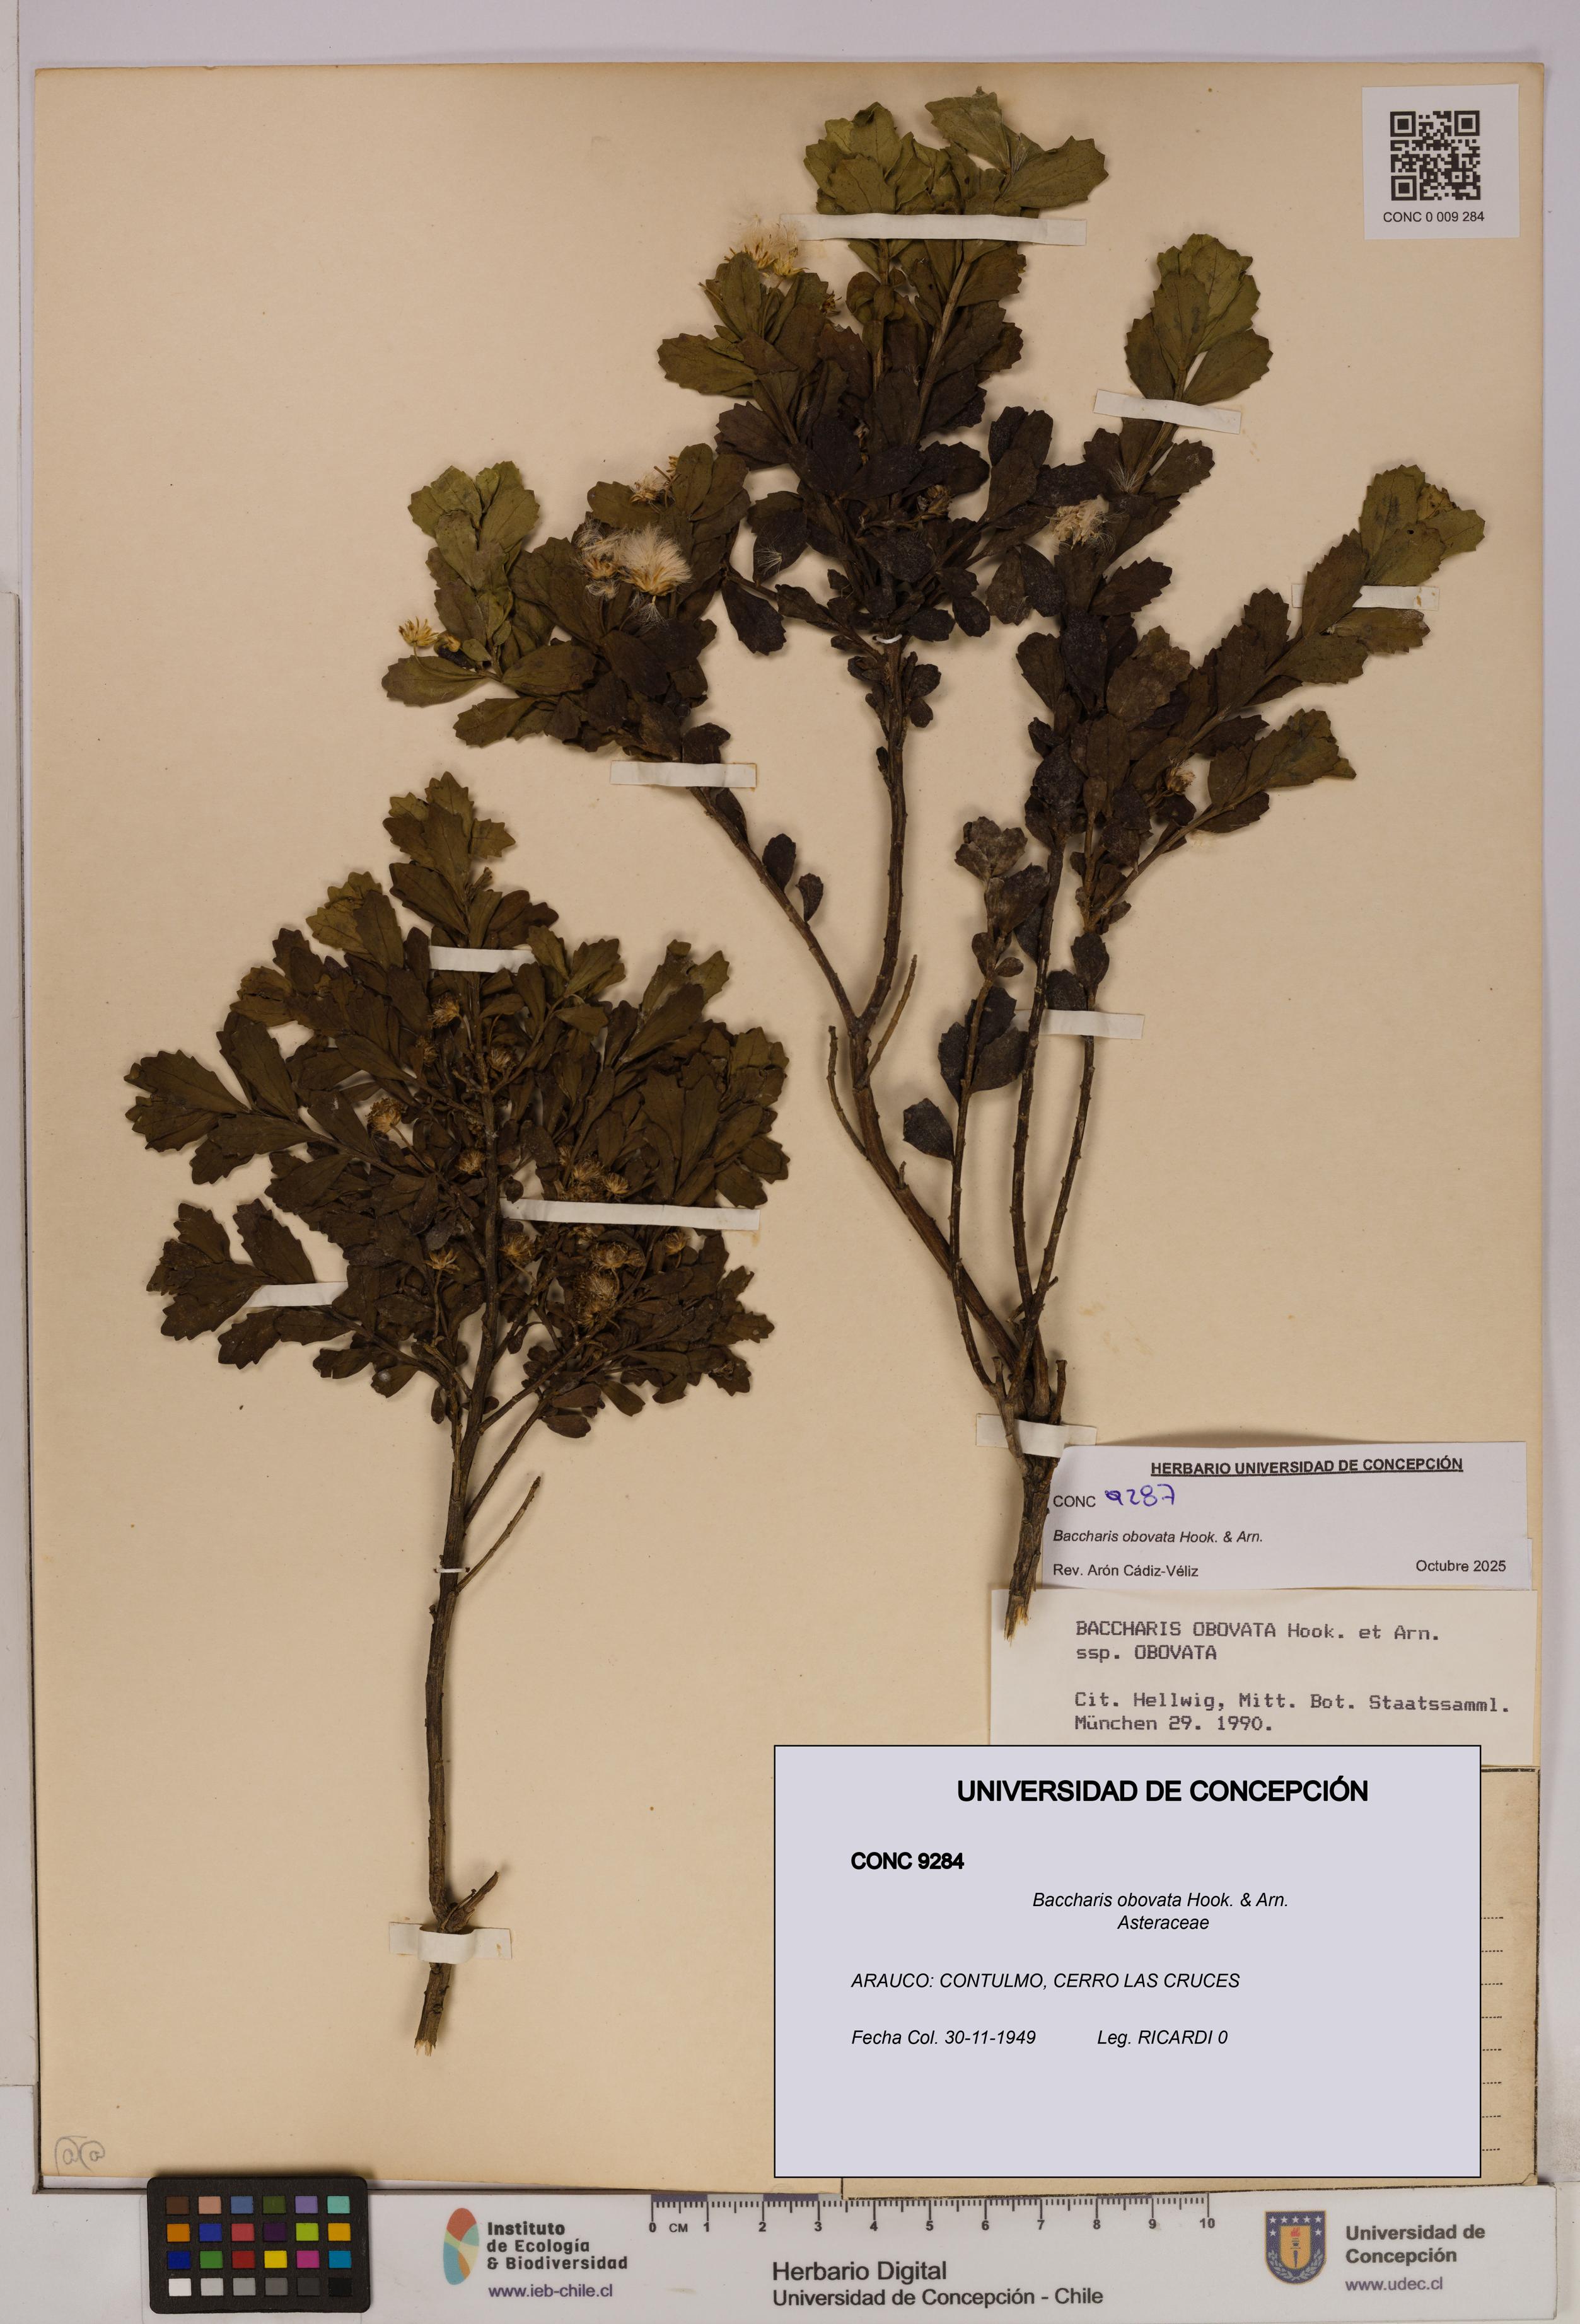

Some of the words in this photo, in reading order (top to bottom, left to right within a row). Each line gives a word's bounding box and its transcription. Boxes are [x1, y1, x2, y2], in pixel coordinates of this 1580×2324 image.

[1383, 211, 1422, 223] CONC
[1426, 211, 1433, 223] 0
[1436, 211, 1459, 223] 009
[1462, 211, 1485, 222] 284
[1151, 1462, 1231, 1477] HERBARIO
[1234, 1459, 1335, 1476] UNIVERSIDAD
[1338, 1459, 1359, 1474] DE
[1362, 1455, 1463, 1473] CONCEPCIÓN
[1052, 1495, 1096, 1508] CONC
[1052, 1529, 1119, 1542] Baccharis
[1122, 1530, 1175, 1543] obovata
[1179, 1531, 1217, 1543] Hook.
[1223, 1530, 1233, 1543] &
[1236, 1530, 1262, 1543] Arn.
[1053, 1563, 1083, 1576] Rev.
[1087, 1564, 1119, 1576] Arón
[1124, 1564, 1199, 1577] Cádiz-Véliz
[1416, 1559, 1469, 1572] Octubre
[1473, 1559, 1506, 1572] 2025
[1076, 1620, 1182, 1636] BACCHARIS
[1193, 1621, 1276, 1638] OBOVATA
[1287, 1622, 1344, 1639] Hook.
[1359, 1624, 1381, 1639] et
[1394, 1625, 1439, 1641] Arn.
[1076, 1648, 1120, 1663] ssp.
[1134, 1645, 1217, 1660] OBOVATA
[1074, 1692, 1119, 1707] Cit.
[1134, 1692, 1224, 1711] Hellwig,
[1239, 1692, 1295, 1708] Mitt.
[1310, 1694, 1354, 1709] Bot.
[1369, 1694, 1509, 1713] Staatssamml.
[1074, 1715, 1158, 1730] München
[1168, 1715, 1201, 1730] 29.
[1217, 1715, 1272, 1731] 1990.
[487, 2221, 566, 2236] Instituto
[648, 2221, 657, 2233] 0
[668, 2223, 688, 2233] CM
[703, 2221, 710, 2233] 1
[758, 2221, 767, 2233] 2
[814, 2220, 823, 2232] 3
[869, 2220, 878, 2232] 4
[925, 2219, 934, 2231] 5
[981, 2219, 990, 2231] 6
[1037, 2218, 1045, 2230] 7
[1093, 2218, 1101, 2230] 8
[1148, 2217, 1157, 2229] 9
[1199, 2217, 1216, 2229] 10
[1346, 2224, 1457, 2241] Universidad
[1462, 2224, 1486, 2240] de
[486, 2239, 508, 2253] de
[514, 2238, 590, 2254] Ecología
[487, 2257, 499, 2270] &
[506, 2255, 627, 2270] Biodiversidad
[1345, 2247, 1457, 2267] Concepción
[773, 2261, 869, 2281] Herbario
[878, 2260, 946, 2286] Digital
[488, 2283, 613, 2298] www.ieb-chile.cl
[1345, 2276, 1443, 2291] www.udec.cl
[773, 2289, 886, 2306] Universidad
[892, 2289, 916, 2306] de
[922, 2287, 1035, 2309] Concepción
[1054, 2287, 1103, 2304] Chile
